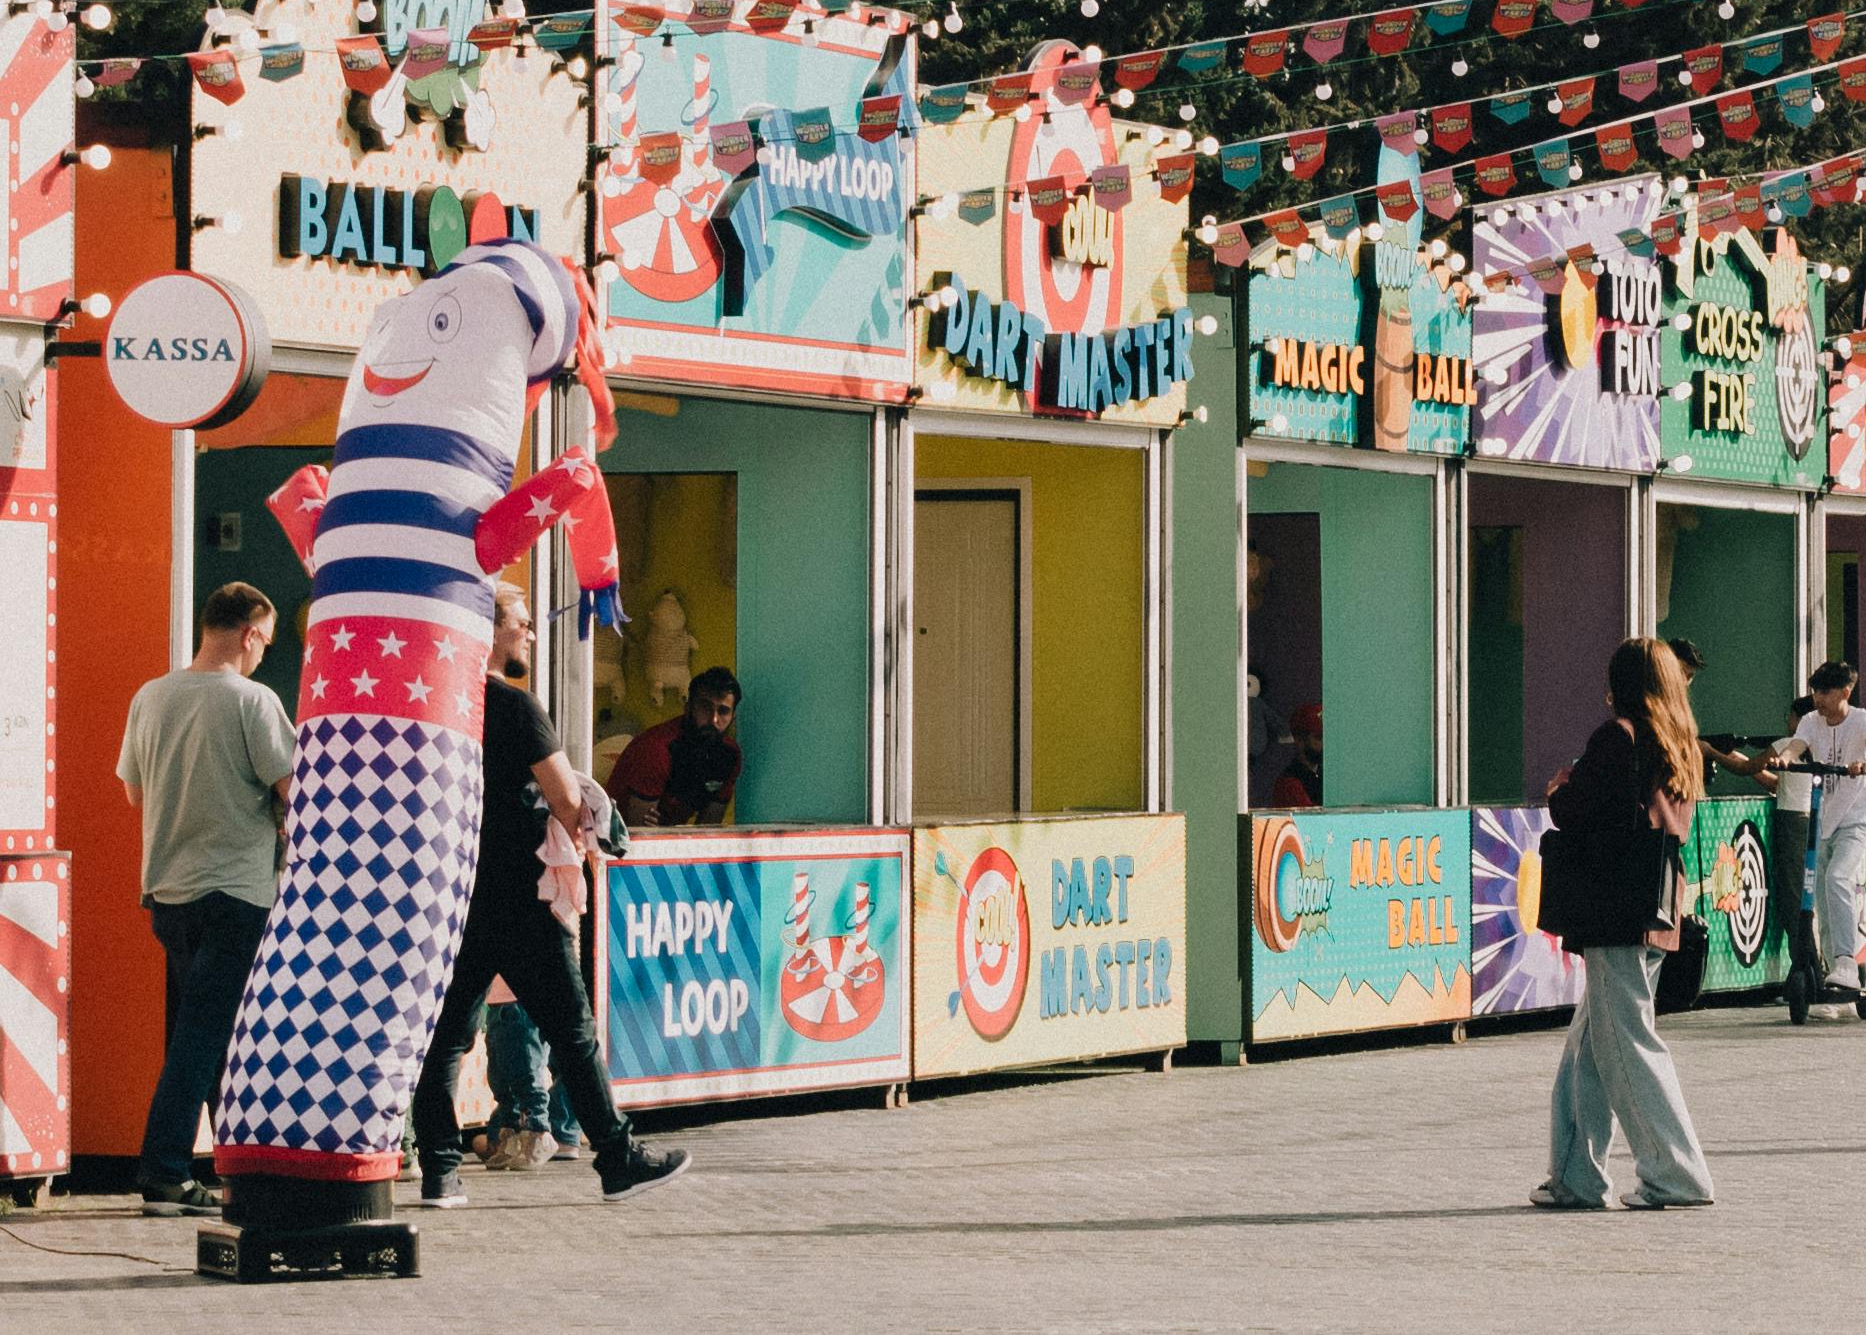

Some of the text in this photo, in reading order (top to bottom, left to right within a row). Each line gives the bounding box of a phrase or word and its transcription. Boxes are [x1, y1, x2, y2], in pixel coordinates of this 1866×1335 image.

[769, 143, 894, 202] HAPPY LOOP
[1611, 260, 1662, 326] TOTO
[112, 336, 236, 363] KASSA
[945, 271, 1195, 414] DART MASTER
[1614, 330, 1662, 396] FUN
[1695, 300, 1764, 363] CROSS
[1274, 337, 1478, 406] MAGIC BALL
[1703, 369, 1756, 436] FIRE
[1051, 854, 1135, 930] DART
[1350, 834, 1442, 890] MAGIC
[626, 897, 734, 959] HAPPY
[1388, 895, 1460, 950] BALL
[662, 978, 750, 1039] LOOP
[1039, 936, 1174, 1020] MASTER
